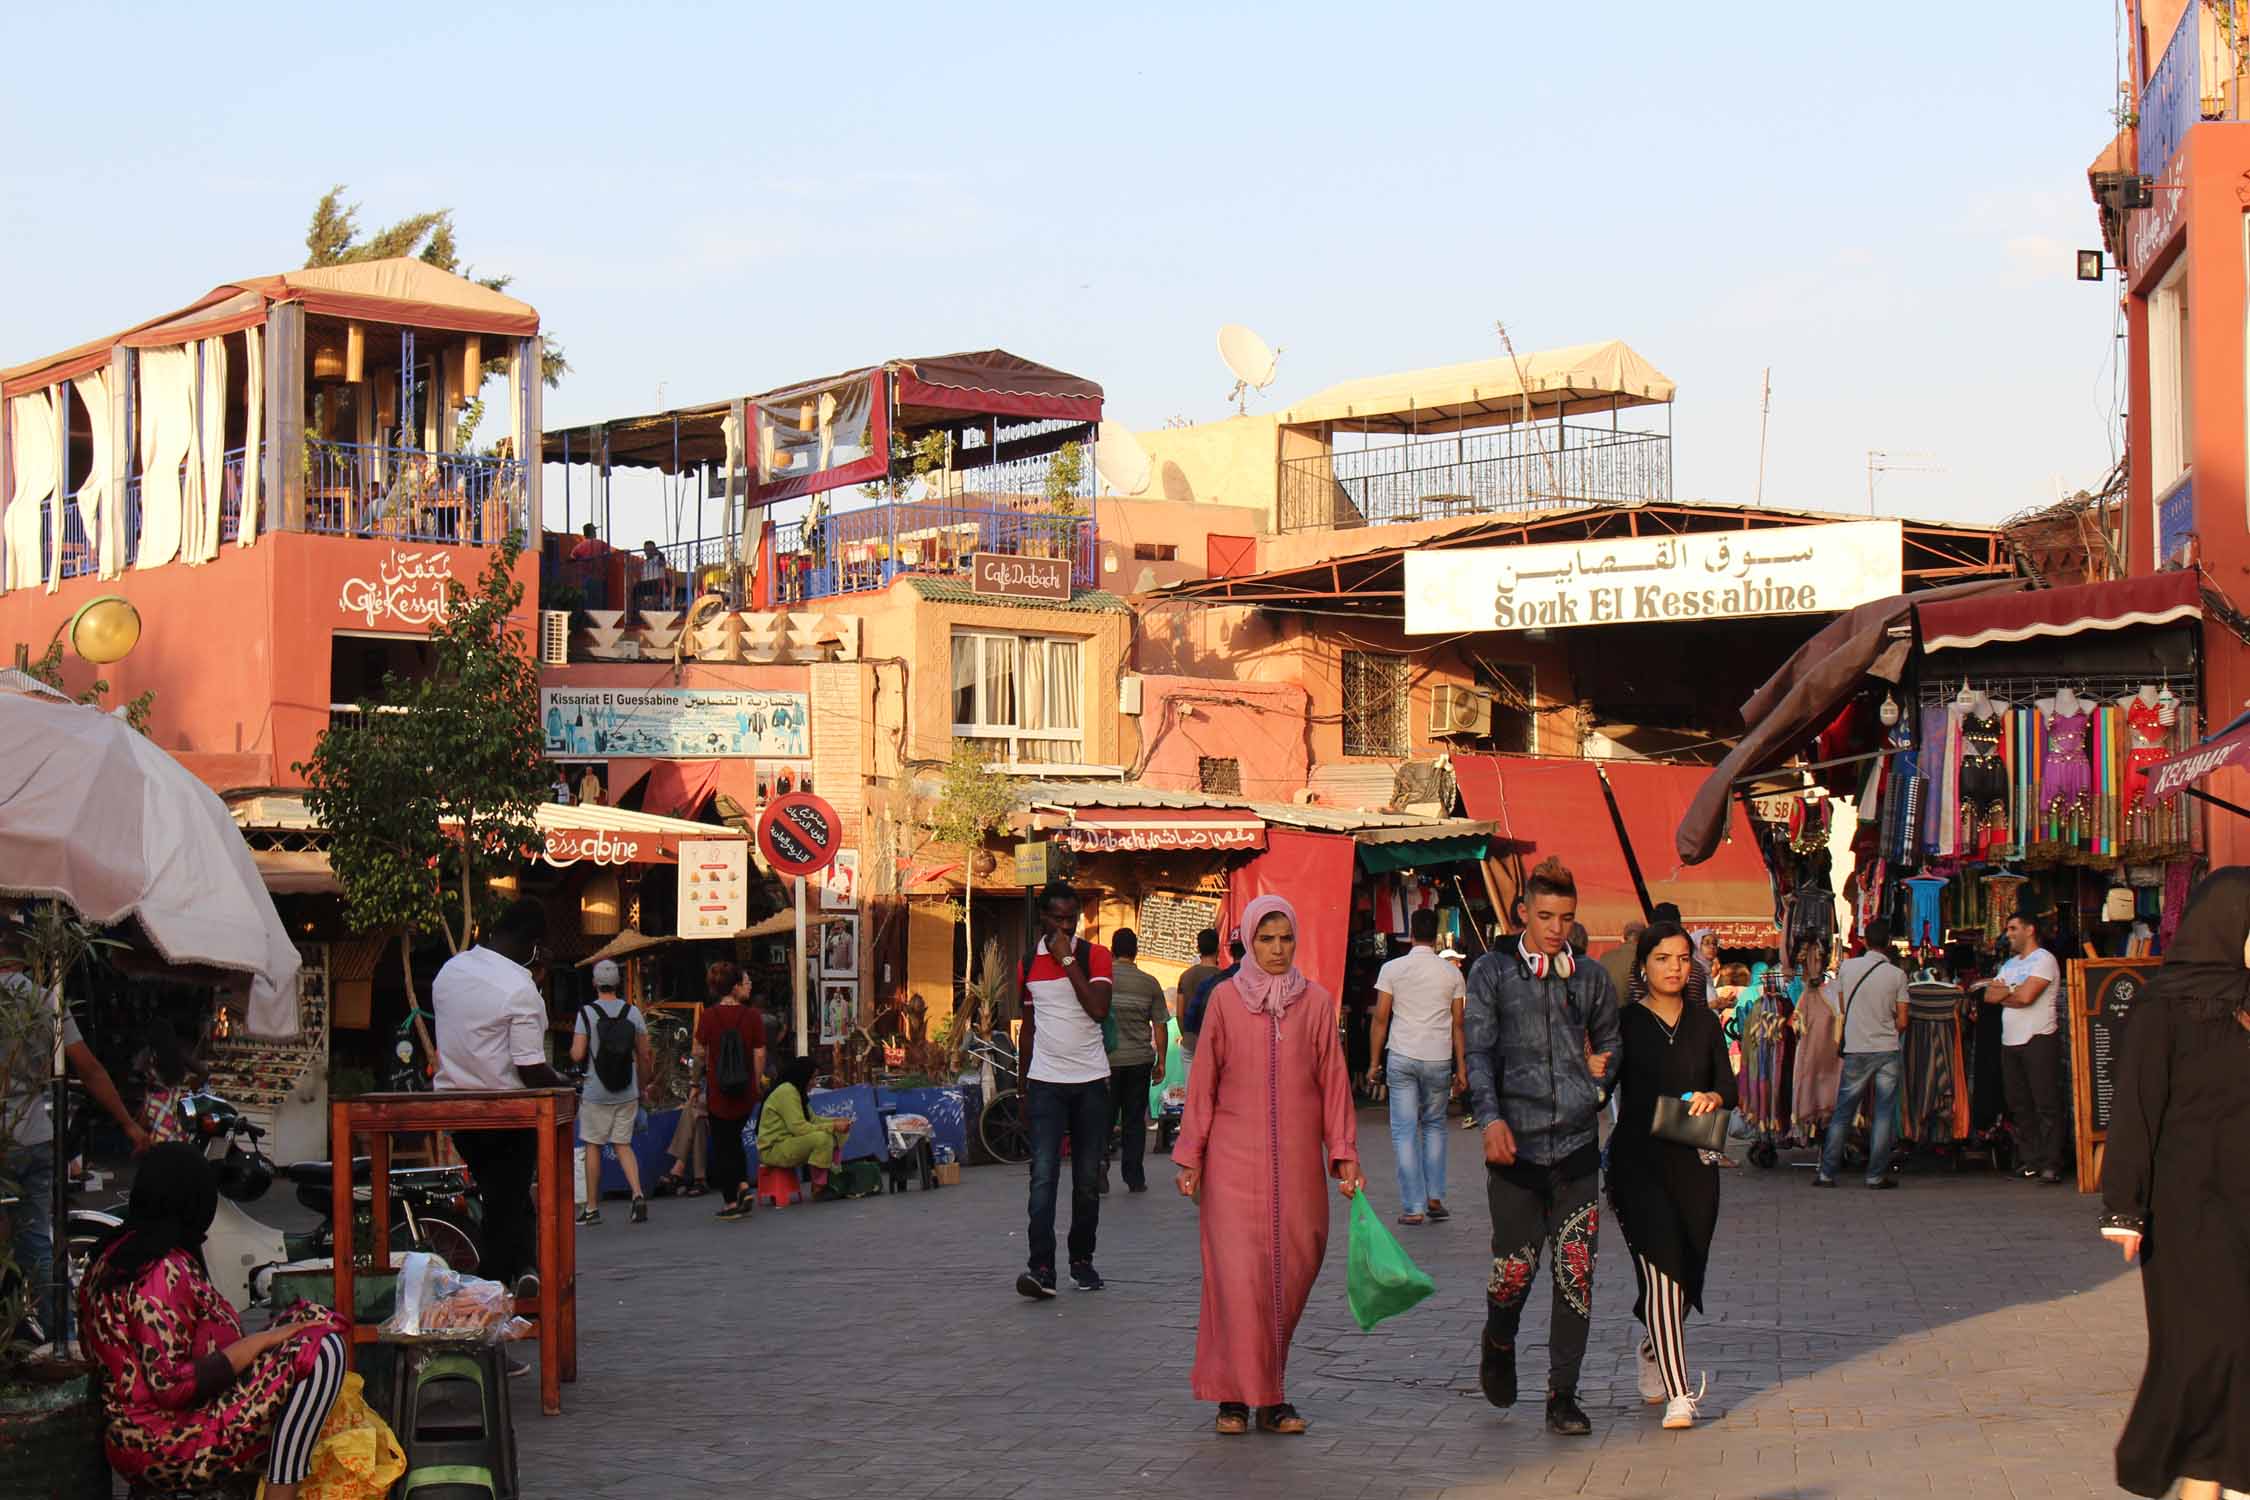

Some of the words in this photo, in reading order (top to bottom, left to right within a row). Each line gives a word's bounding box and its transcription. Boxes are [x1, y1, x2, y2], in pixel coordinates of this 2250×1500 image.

[985, 562, 1013, 591] Café
[1496, 538, 1688, 593] القصابين
[1704, 536, 1814, 578] سوق
[342, 578, 384, 627] Café
[1494, 591, 1579, 629] Souk
[1589, 588, 1623, 622] El
[1634, 577, 1817, 620] Kessabine
[550, 693, 600, 705] Kissariat
[603, 693, 613, 705] El
[616, 693, 679, 706] Guessabine
[799, 808, 828, 829] ممنوع
[541, 829, 638, 868] essabine
